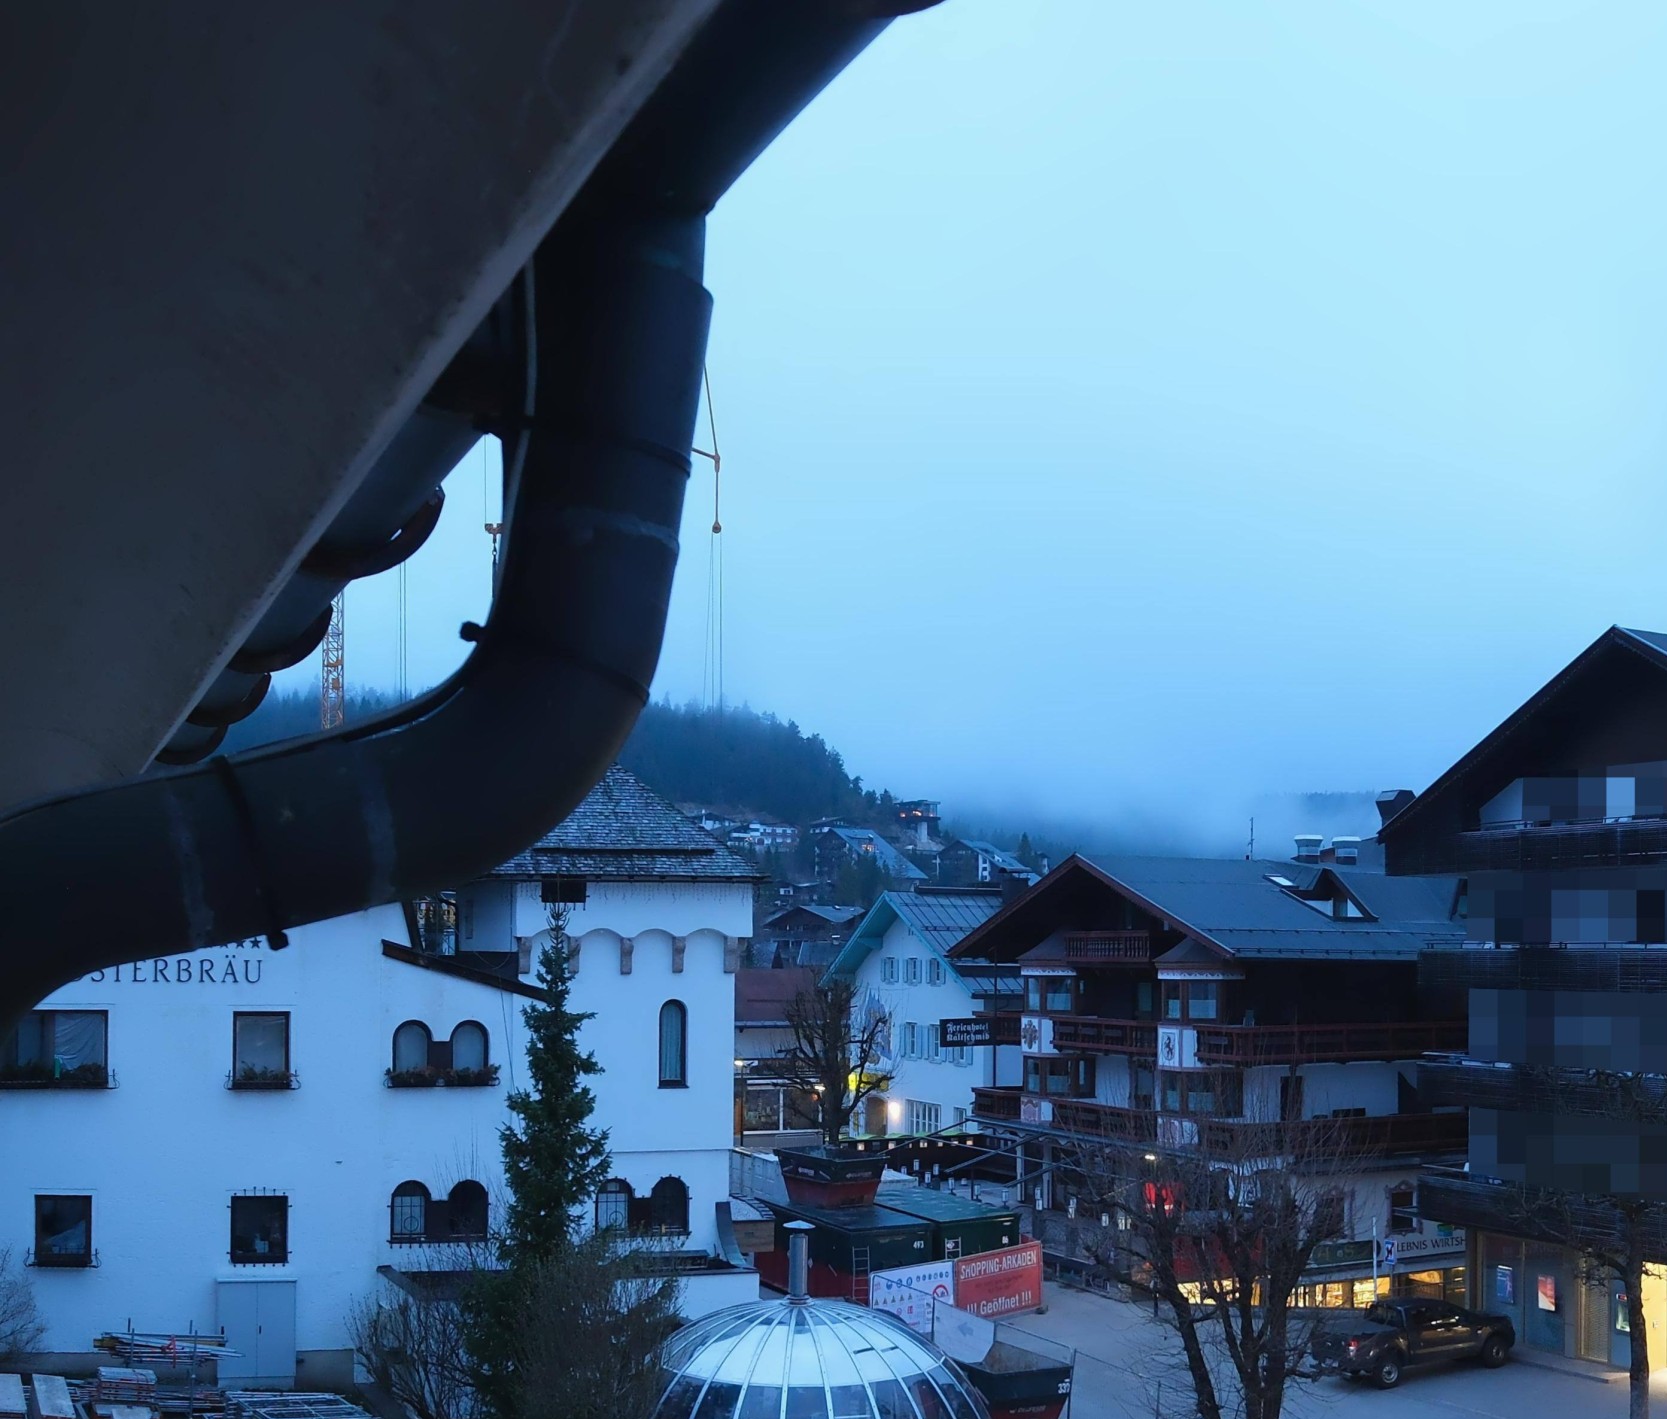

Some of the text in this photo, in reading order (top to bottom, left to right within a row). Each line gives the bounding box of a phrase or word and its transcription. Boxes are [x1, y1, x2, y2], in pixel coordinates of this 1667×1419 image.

[71, 955, 262, 984] STERBRÄU
[960, 1249, 1037, 1279] SHOPPING-ARKADEN
[979, 1295, 1021, 1316] Geöffnet
